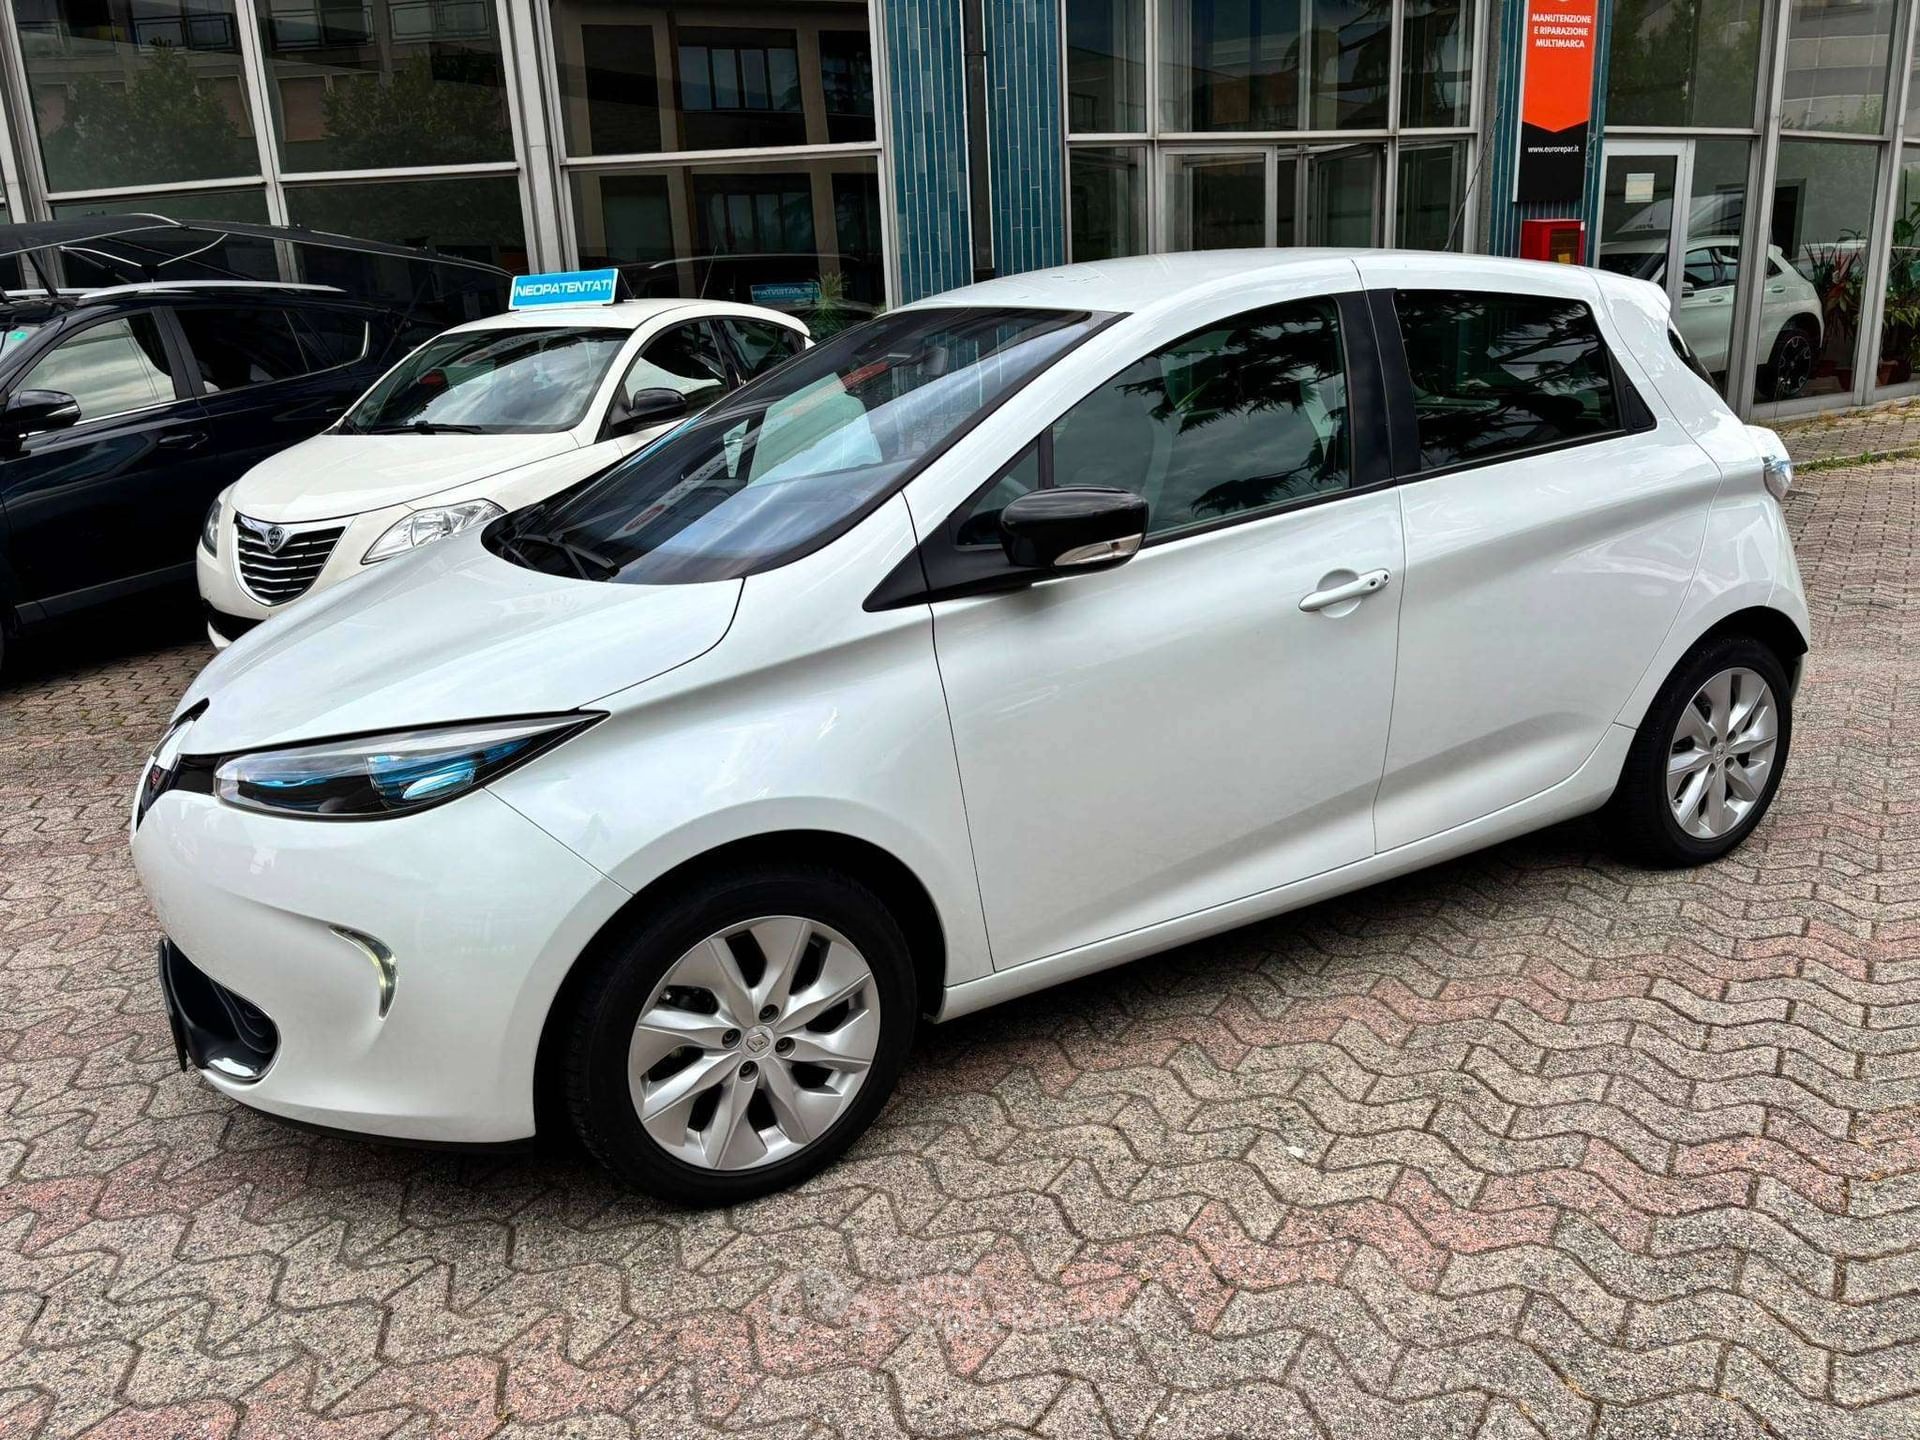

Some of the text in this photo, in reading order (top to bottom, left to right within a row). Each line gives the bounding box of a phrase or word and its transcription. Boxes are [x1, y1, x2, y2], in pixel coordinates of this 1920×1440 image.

[1532, 13, 1592, 23] MANUTENZIONE
[1533, 26, 1589, 36] E RIPARAZIONE
[1535, 39, 1585, 48] MULTIMARCA
[1528, 144, 1579, 154] www.eurorepar.it
[515, 279, 612, 297] NEOPATENTATI
